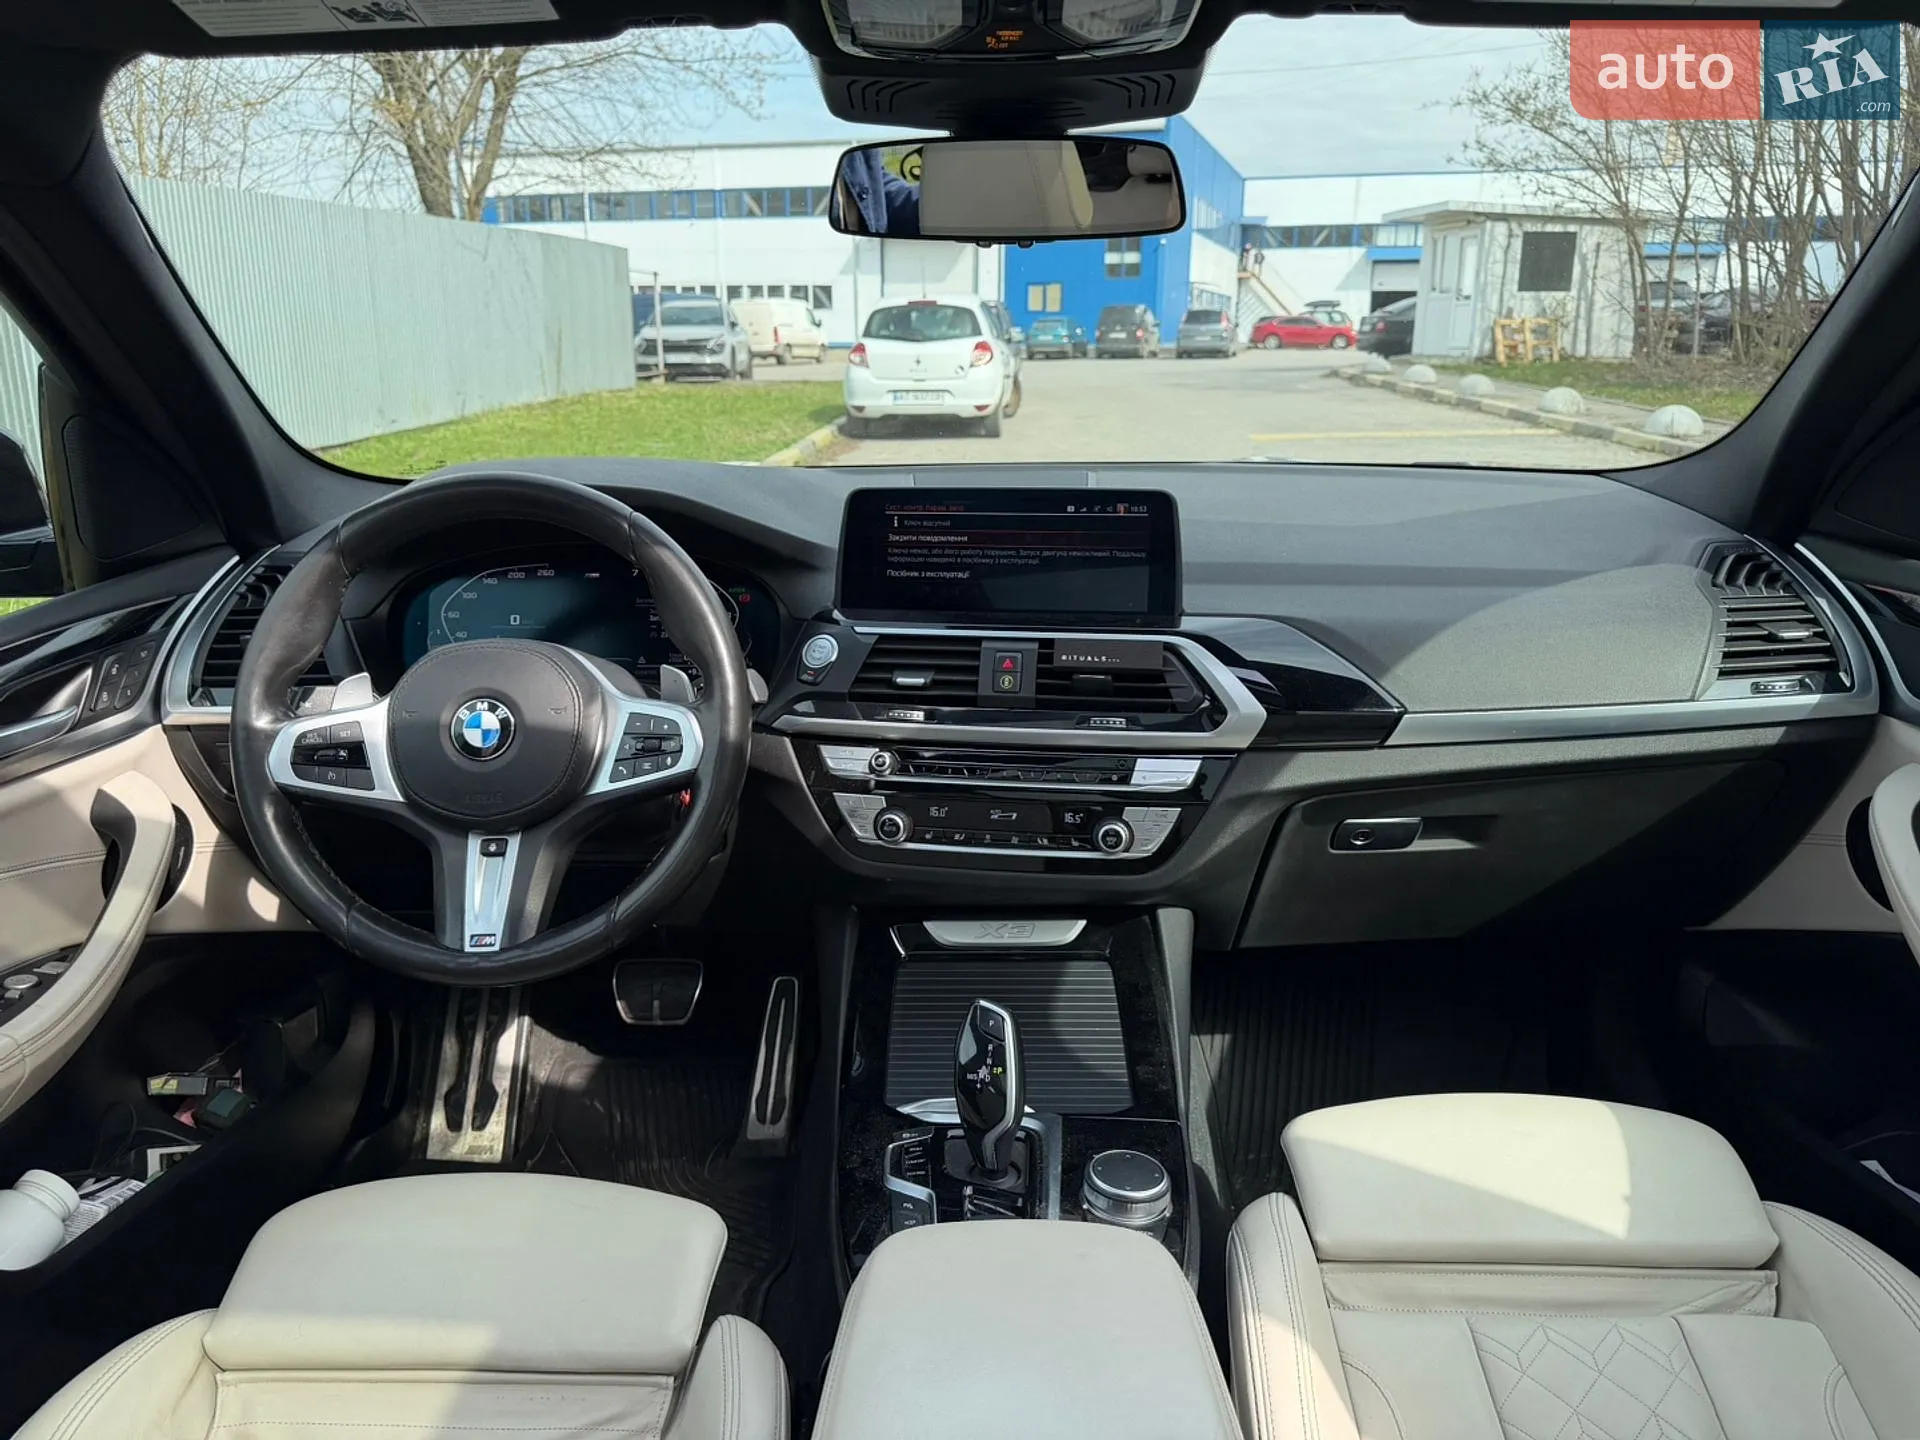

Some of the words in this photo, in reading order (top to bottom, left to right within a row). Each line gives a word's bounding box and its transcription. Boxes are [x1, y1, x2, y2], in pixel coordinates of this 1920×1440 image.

[887, 533, 917, 542] Закрити
[507, 571, 526, 579] 200
[536, 569, 555, 577] 260
[886, 568, 920, 577] Посібник
[482, 577, 498, 585] 140
[462, 591, 478, 599] 100
[509, 614, 520, 625] 0
[458, 702, 508, 720] BMW
[974, 921, 1035, 939] X3
